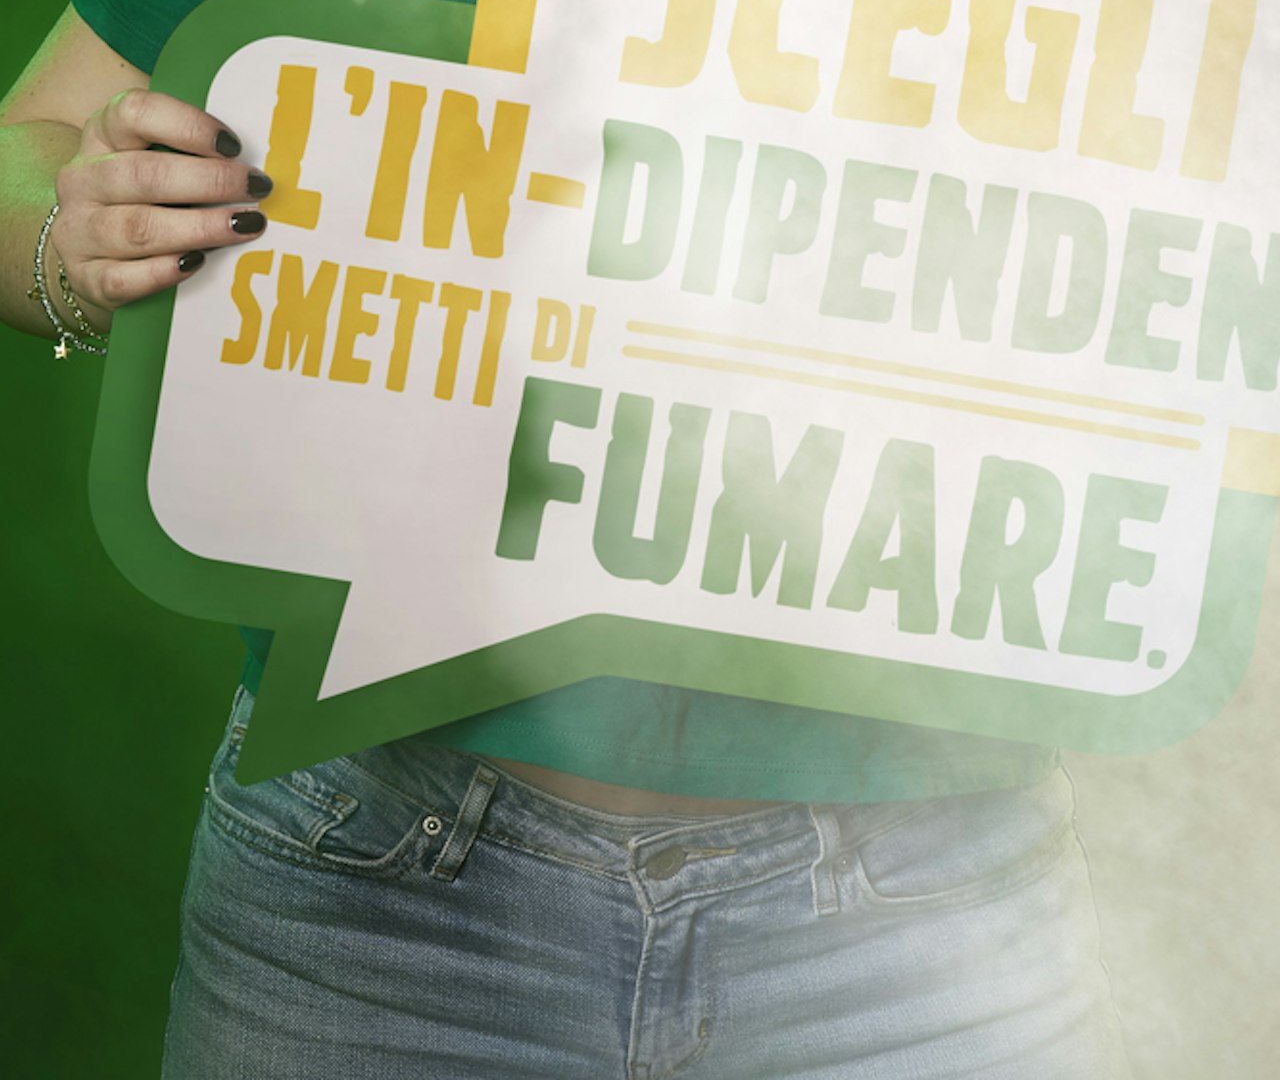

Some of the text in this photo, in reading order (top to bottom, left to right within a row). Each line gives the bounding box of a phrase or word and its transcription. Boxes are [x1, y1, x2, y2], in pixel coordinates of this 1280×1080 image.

[220, 249, 597, 407] SMETTI DI
[494, 376, 1168, 670] FUMARE.
